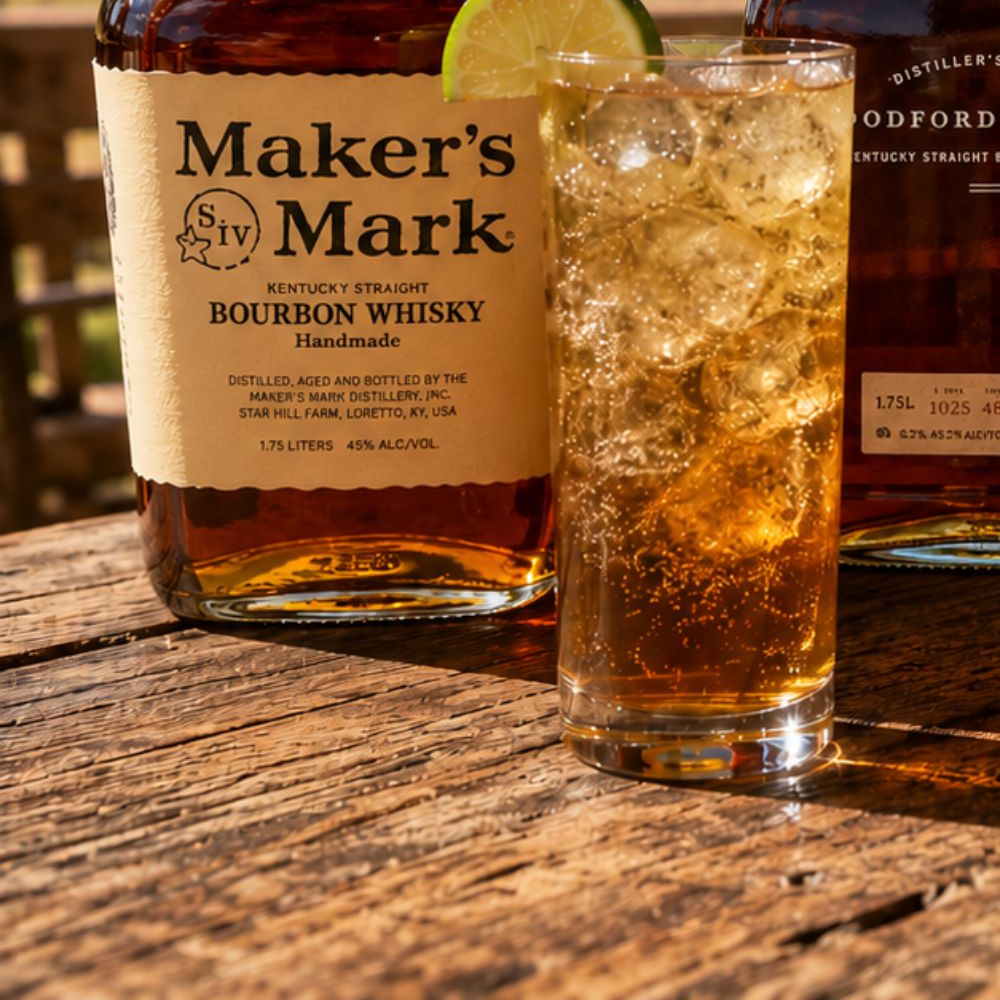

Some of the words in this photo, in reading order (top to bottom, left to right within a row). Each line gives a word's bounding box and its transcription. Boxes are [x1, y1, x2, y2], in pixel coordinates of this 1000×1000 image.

[853, 109, 996, 129] ODFORD
[175, 120, 516, 179] Maker's
[853, 151, 916, 163] ENTUCKY
[922, 151, 989, 163] STRAIGHT
[267, 282, 349, 294] KENTUCKY
[354, 282, 430, 294] STRAIGHT
[208, 301, 357, 325] BOURBON
[365, 300, 486, 325] WHISKY
[295, 333, 401, 348] Handmade
[297, 375, 331, 387] AGED
[334, 375, 361, 387] AND
[364, 374, 420, 386] BOTTLED
[423, 374, 440, 385] BY
[443, 373, 468, 384] THE
[249, 391, 305, 403] MAKER'S
[308, 391, 345, 402] MARK
[425, 389, 451, 401] INC.
[238, 407, 270, 419] STAR
[273, 407, 302, 419] HILL
[304, 407, 342, 420] FARM,
[346, 407, 406, 420] LORETTO,
[410, 406, 428, 419] KY,
[431, 405, 457, 417] USA
[287, 440, 334, 452] LITERS
[346, 440, 375, 450] 45%
[378, 438, 440, 451] ALC/VOL.
